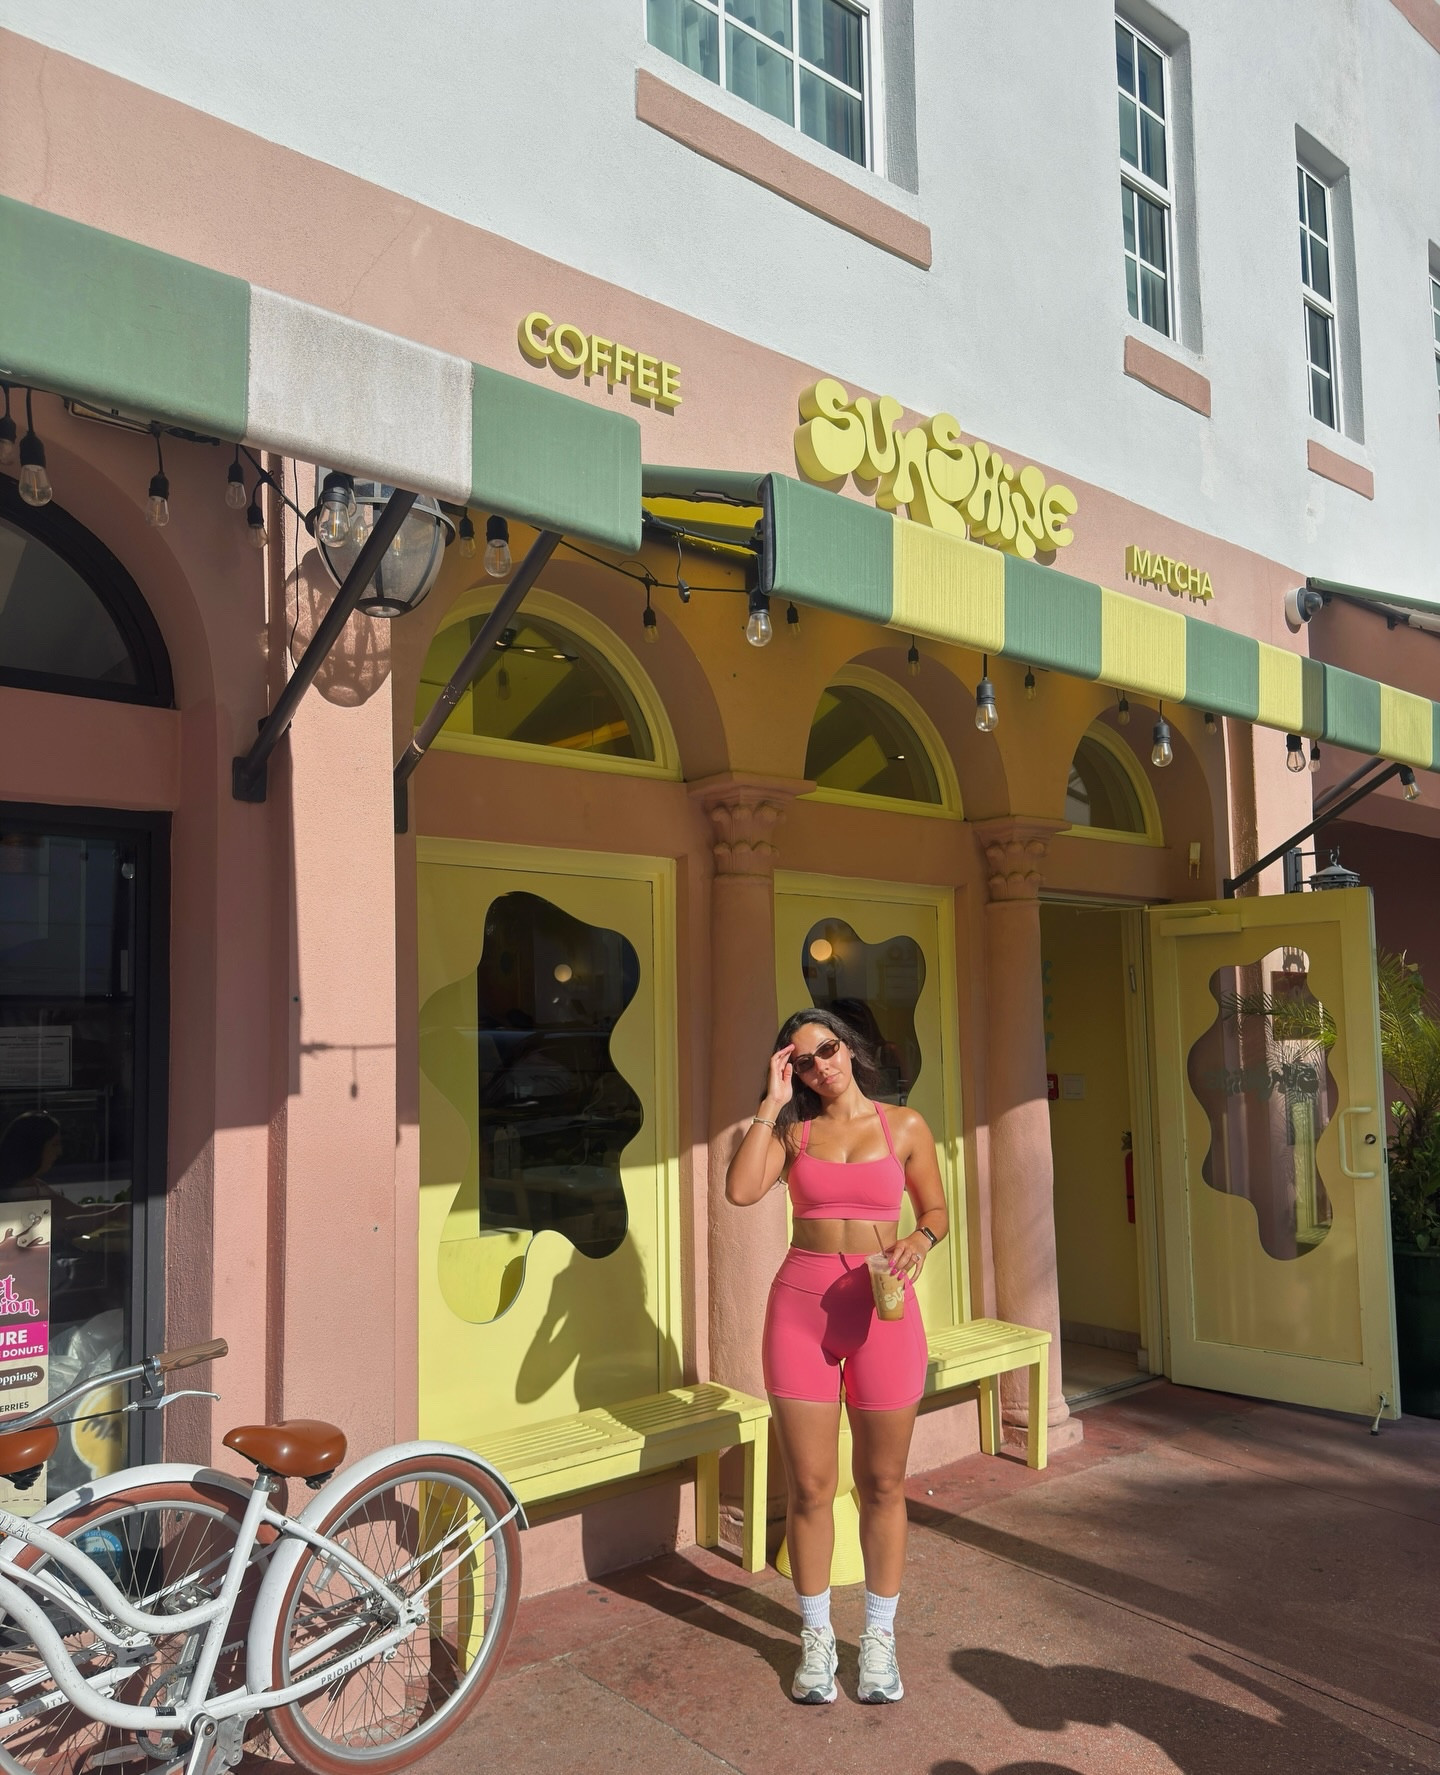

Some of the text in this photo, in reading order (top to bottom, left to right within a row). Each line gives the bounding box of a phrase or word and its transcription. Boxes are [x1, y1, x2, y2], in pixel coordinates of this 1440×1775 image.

[518, 312, 683, 408] COFFEE
[1125, 544, 1215, 600] MATCHA
[2, 1344, 44, 1358] DONUTS
[321, 1655, 364, 1685] PRIORITY
[8, 1695, 64, 1724] PRITY
